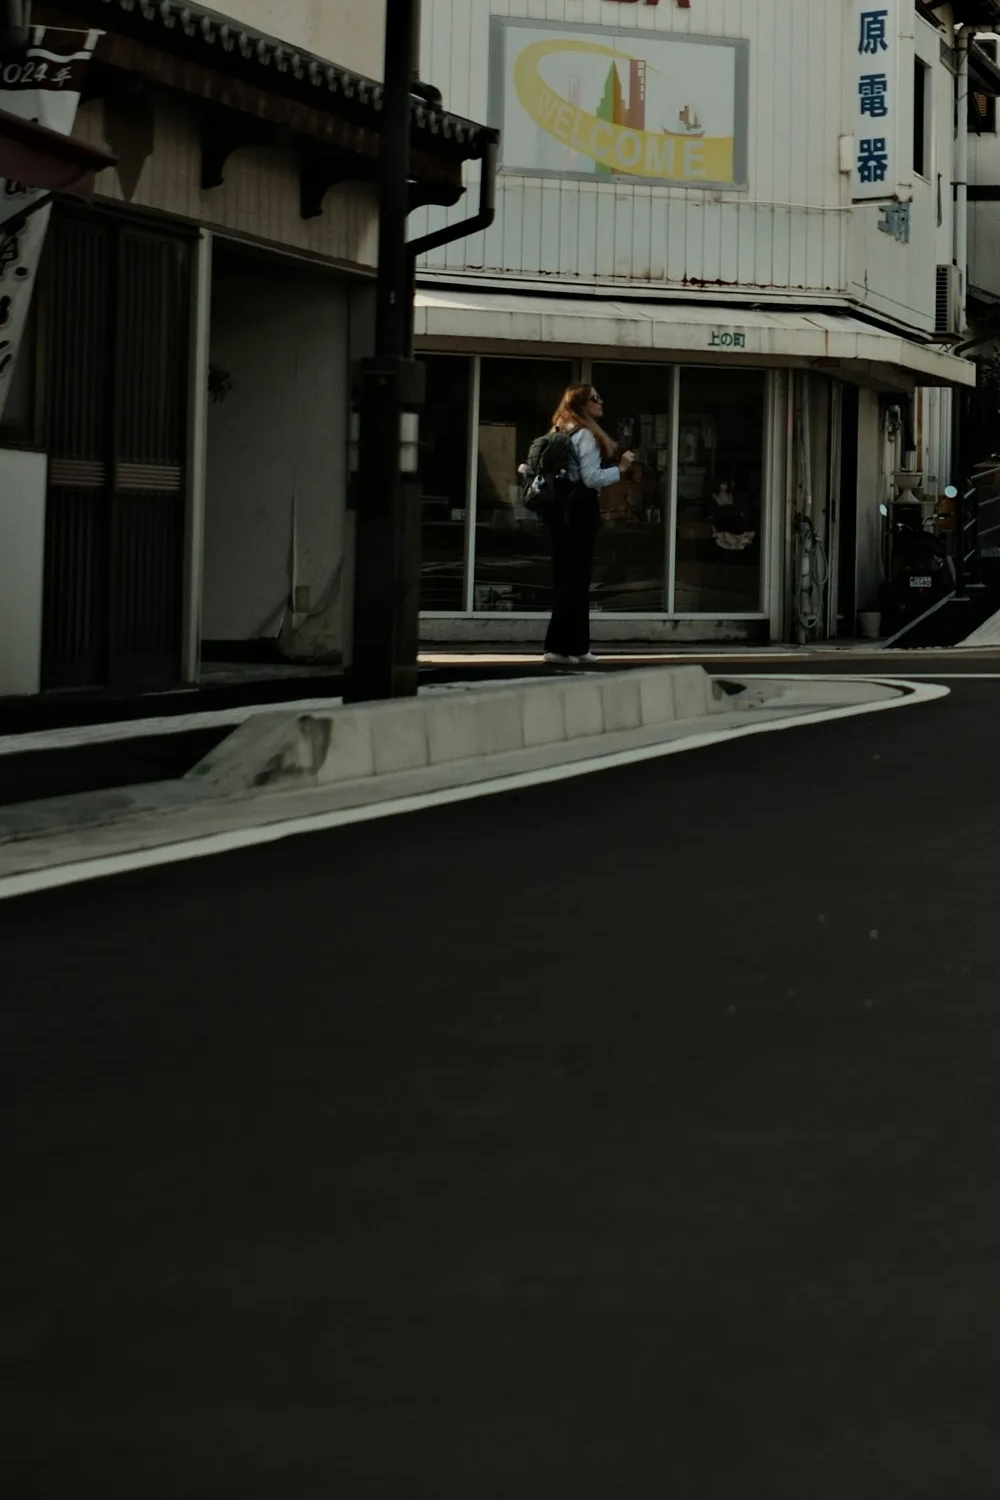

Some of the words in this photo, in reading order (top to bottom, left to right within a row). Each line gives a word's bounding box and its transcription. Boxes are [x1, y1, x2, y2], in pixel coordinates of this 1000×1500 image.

[0, 62, 73, 87] 024年
[536, 85, 706, 177] WELCOME
[707, 331, 746, 348] 上の町
